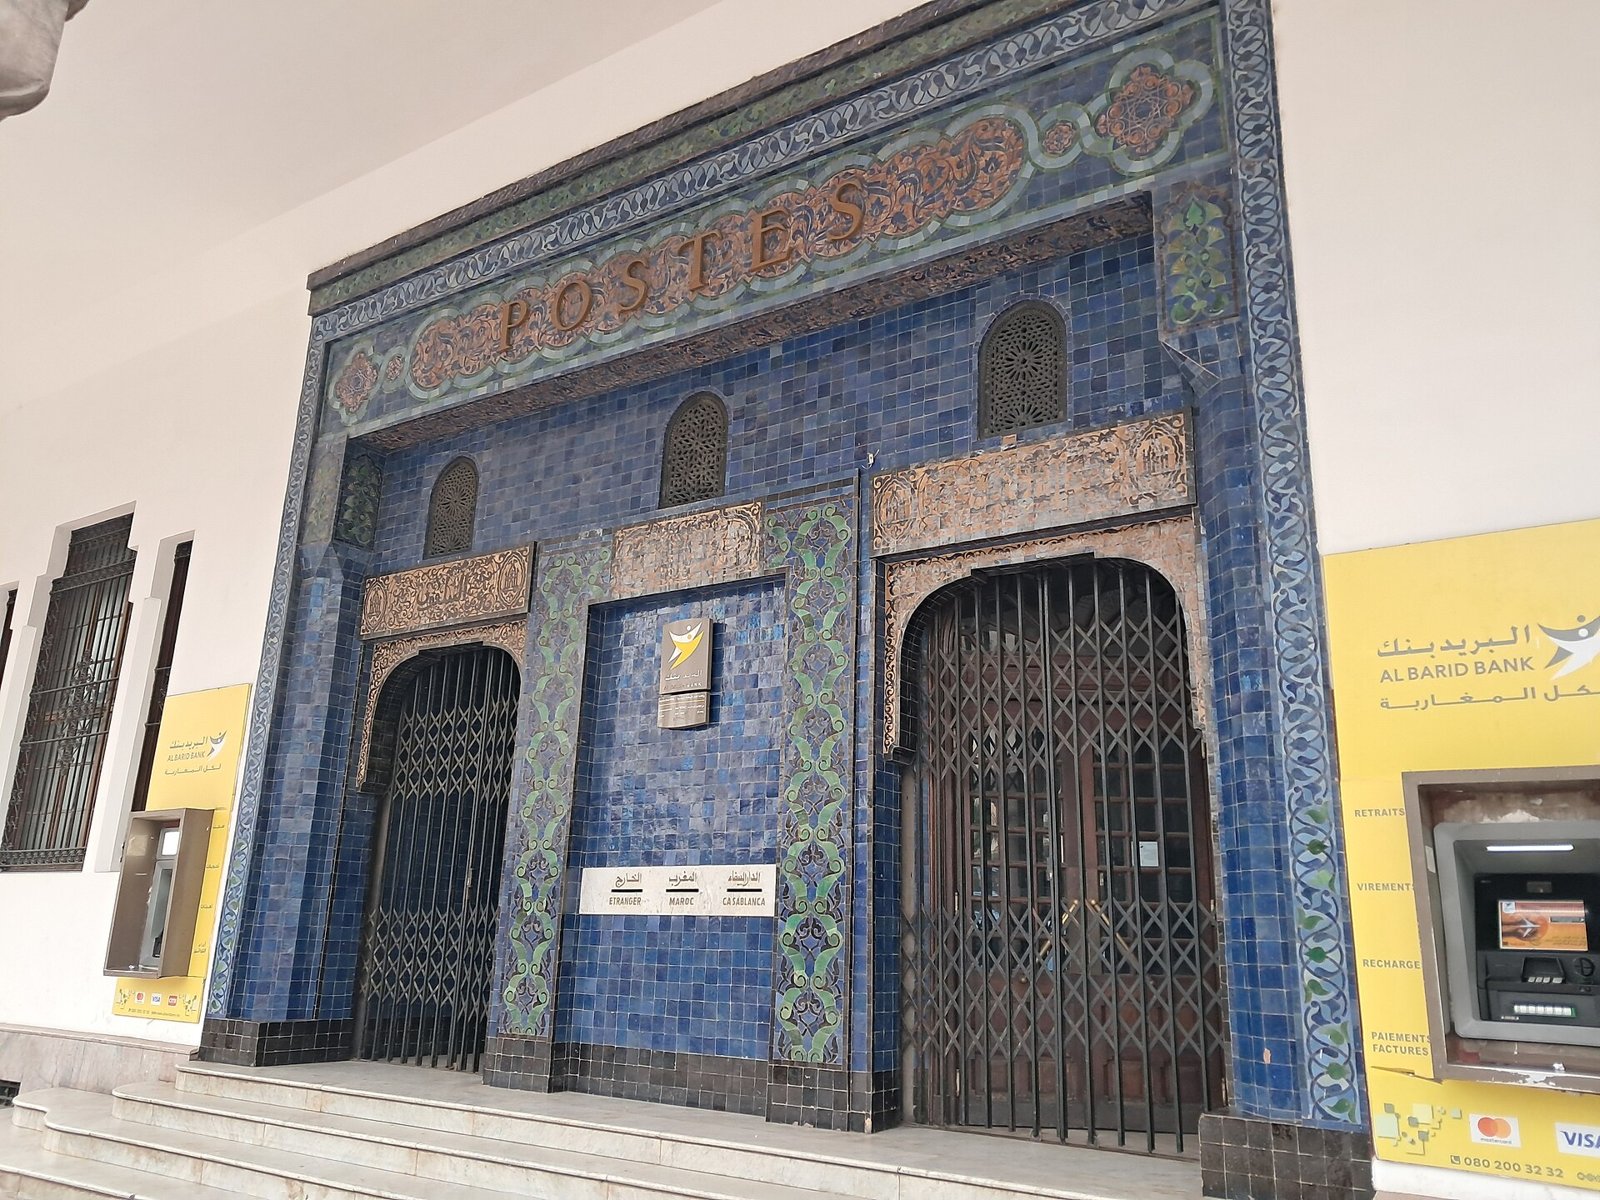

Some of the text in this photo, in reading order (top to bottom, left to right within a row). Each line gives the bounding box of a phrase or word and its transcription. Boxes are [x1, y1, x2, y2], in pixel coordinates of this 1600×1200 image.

[499, 178, 866, 353] POSTES
[1377, 624, 1531, 659] البريد بنك
[1380, 656, 1536, 684] AL BARID BANK
[1380, 686, 1536, 711] المغاربة
[1354, 807, 1406, 818] RETRAITS
[615, 871, 643, 888] الخارج
[668, 870, 698, 887] المغرب
[1356, 882, 1414, 892] VIREMENT
[608, 896, 642, 906] ETRANGER
[668, 897, 695, 906] MAROC
[722, 897, 766, 906] CASABLANCA
[1362, 958, 1422, 969] RECHARGE
[1372, 1043, 1429, 1056] FACTURES
[1463, 1156, 1564, 1178] 080 200 32 32
